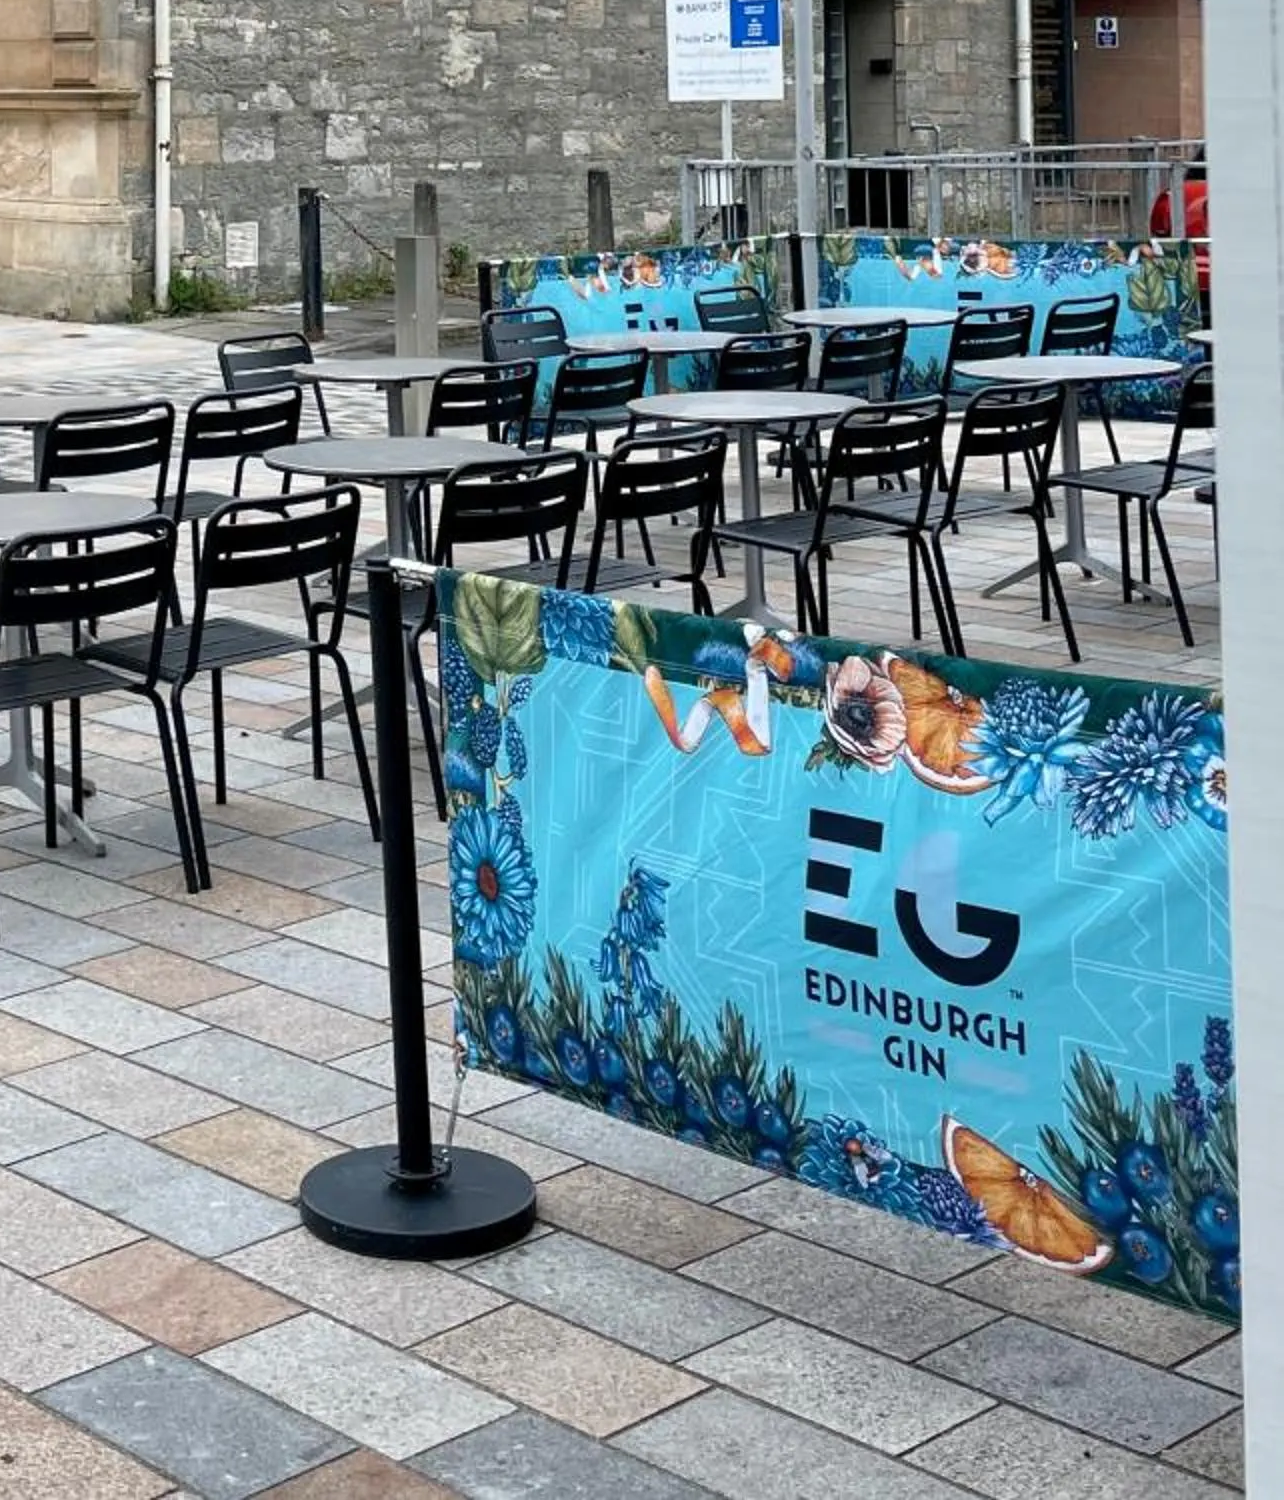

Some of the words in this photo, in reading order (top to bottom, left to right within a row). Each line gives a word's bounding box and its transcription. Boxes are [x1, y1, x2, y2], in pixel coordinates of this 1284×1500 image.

[804, 807, 1021, 987] EG
[804, 967, 1027, 1056] EDINBURGH
[883, 1035, 947, 1081] GIN
